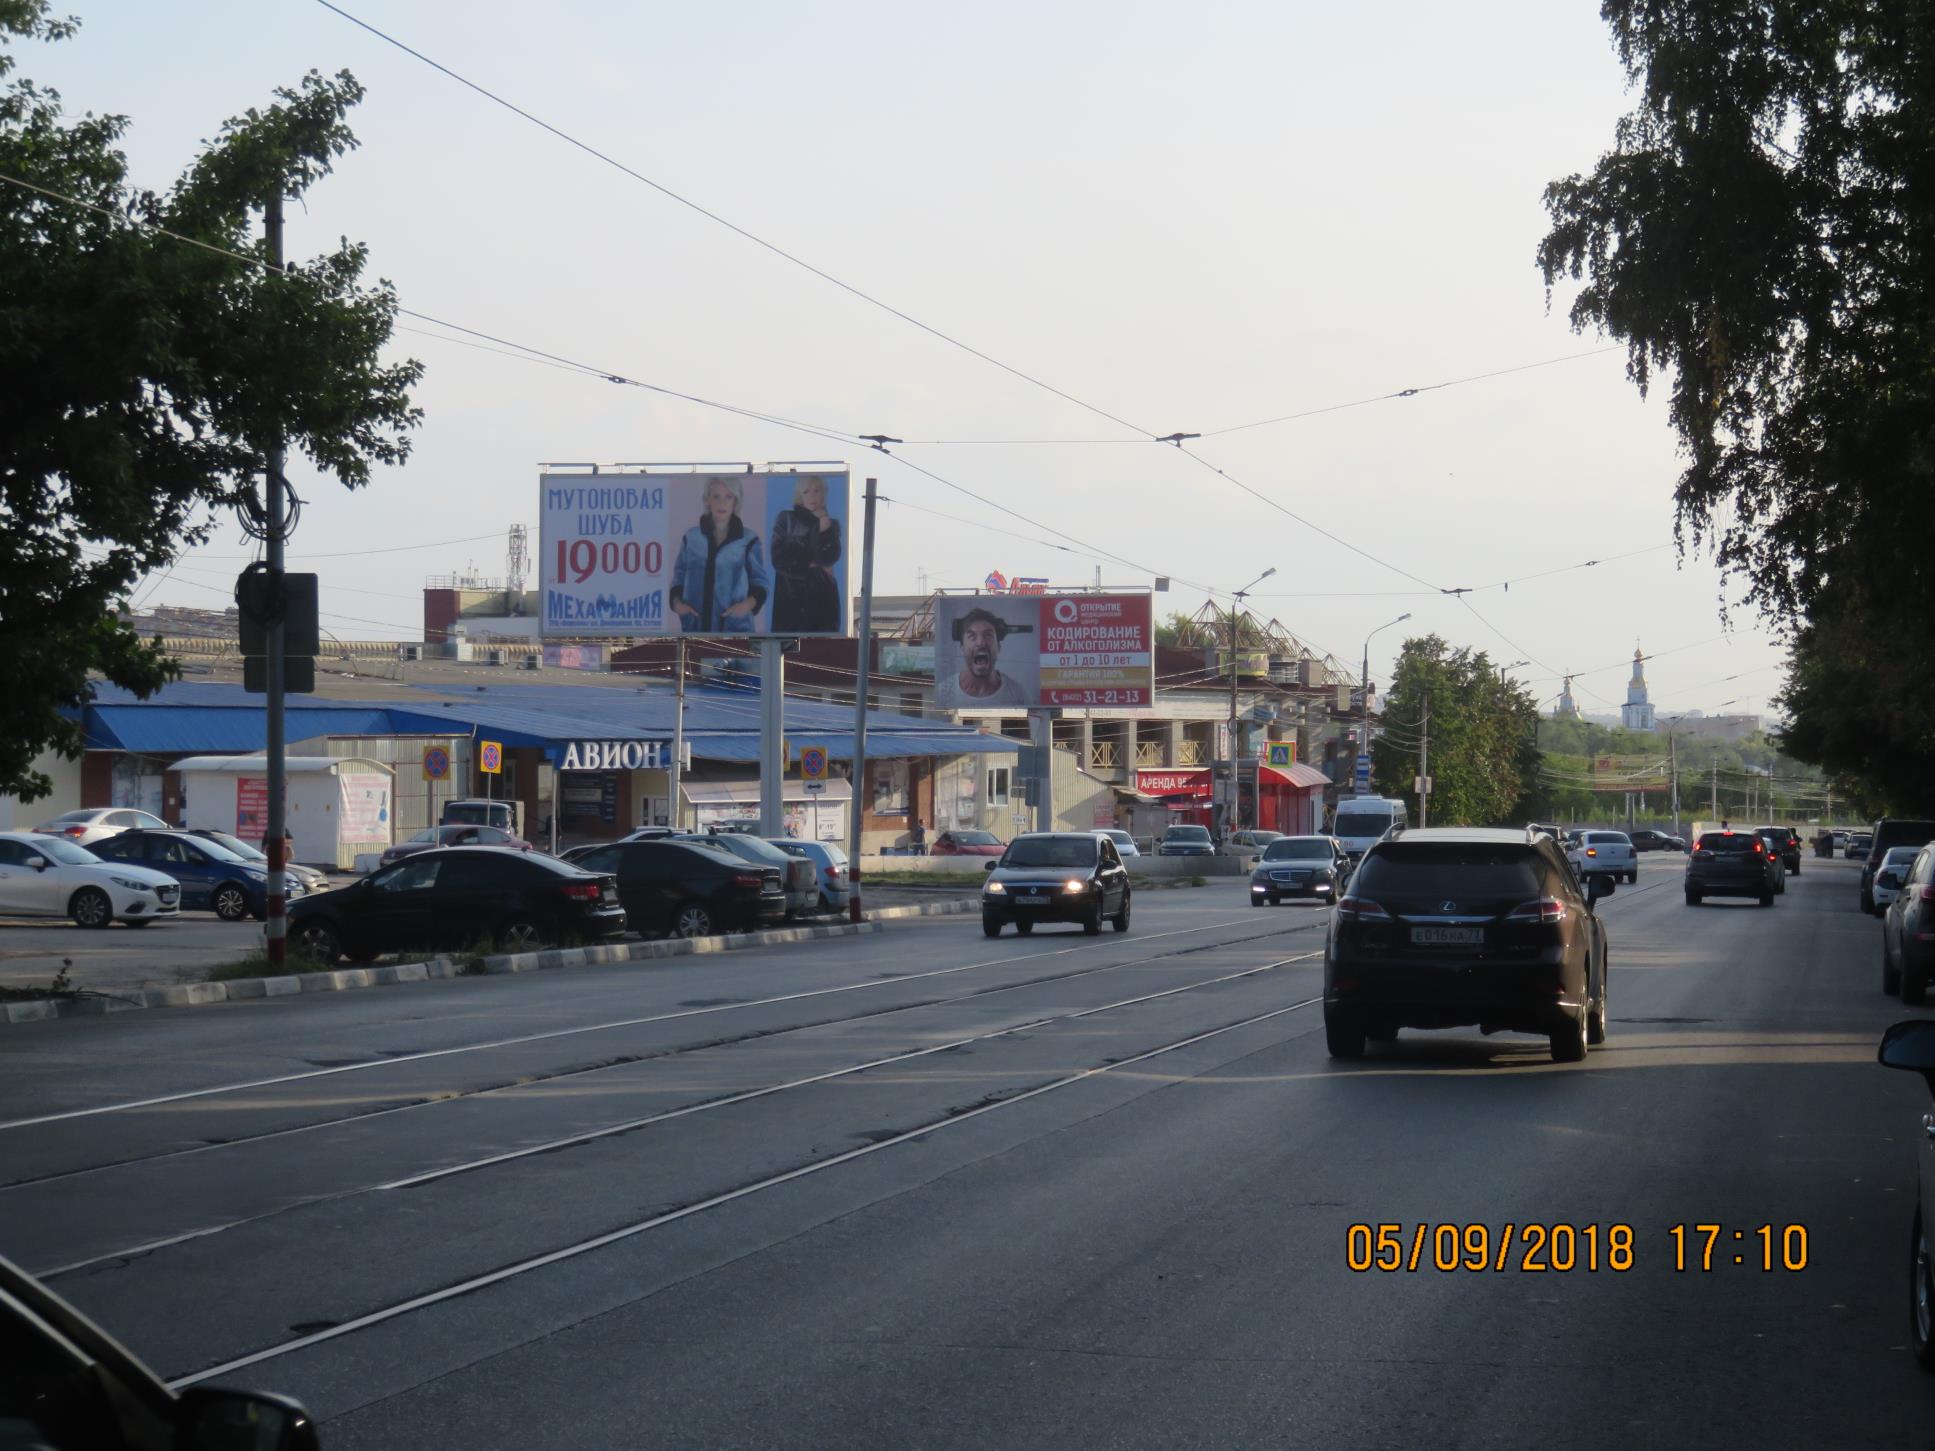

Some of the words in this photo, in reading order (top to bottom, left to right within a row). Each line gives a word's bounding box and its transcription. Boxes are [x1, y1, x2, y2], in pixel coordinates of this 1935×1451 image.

[548, 488, 663, 510] МУТОНОВАЯ
[578, 514, 633, 535] ШУБА
[548, 589, 662, 619] МЕХАМАНИЯ
[1080, 603, 1121, 611] ОТКРЫТИЕ
[1047, 626, 1141, 640] КОДИРОВАНИЕ
[1047, 641, 1060, 651] ОТ
[1063, 639, 1142, 651] АЛКОГОЛИЗМА
[1060, 657, 1070, 666] от
[1081, 656, 1096, 668] до
[1099, 654, 1110, 665] 10
[1113, 656, 1131, 664] лет
[1084, 690, 1140, 704] 31-21-13
[560, 741, 663, 770] АВИОН
[1141, 778, 1176, 790] АРЕНДА
